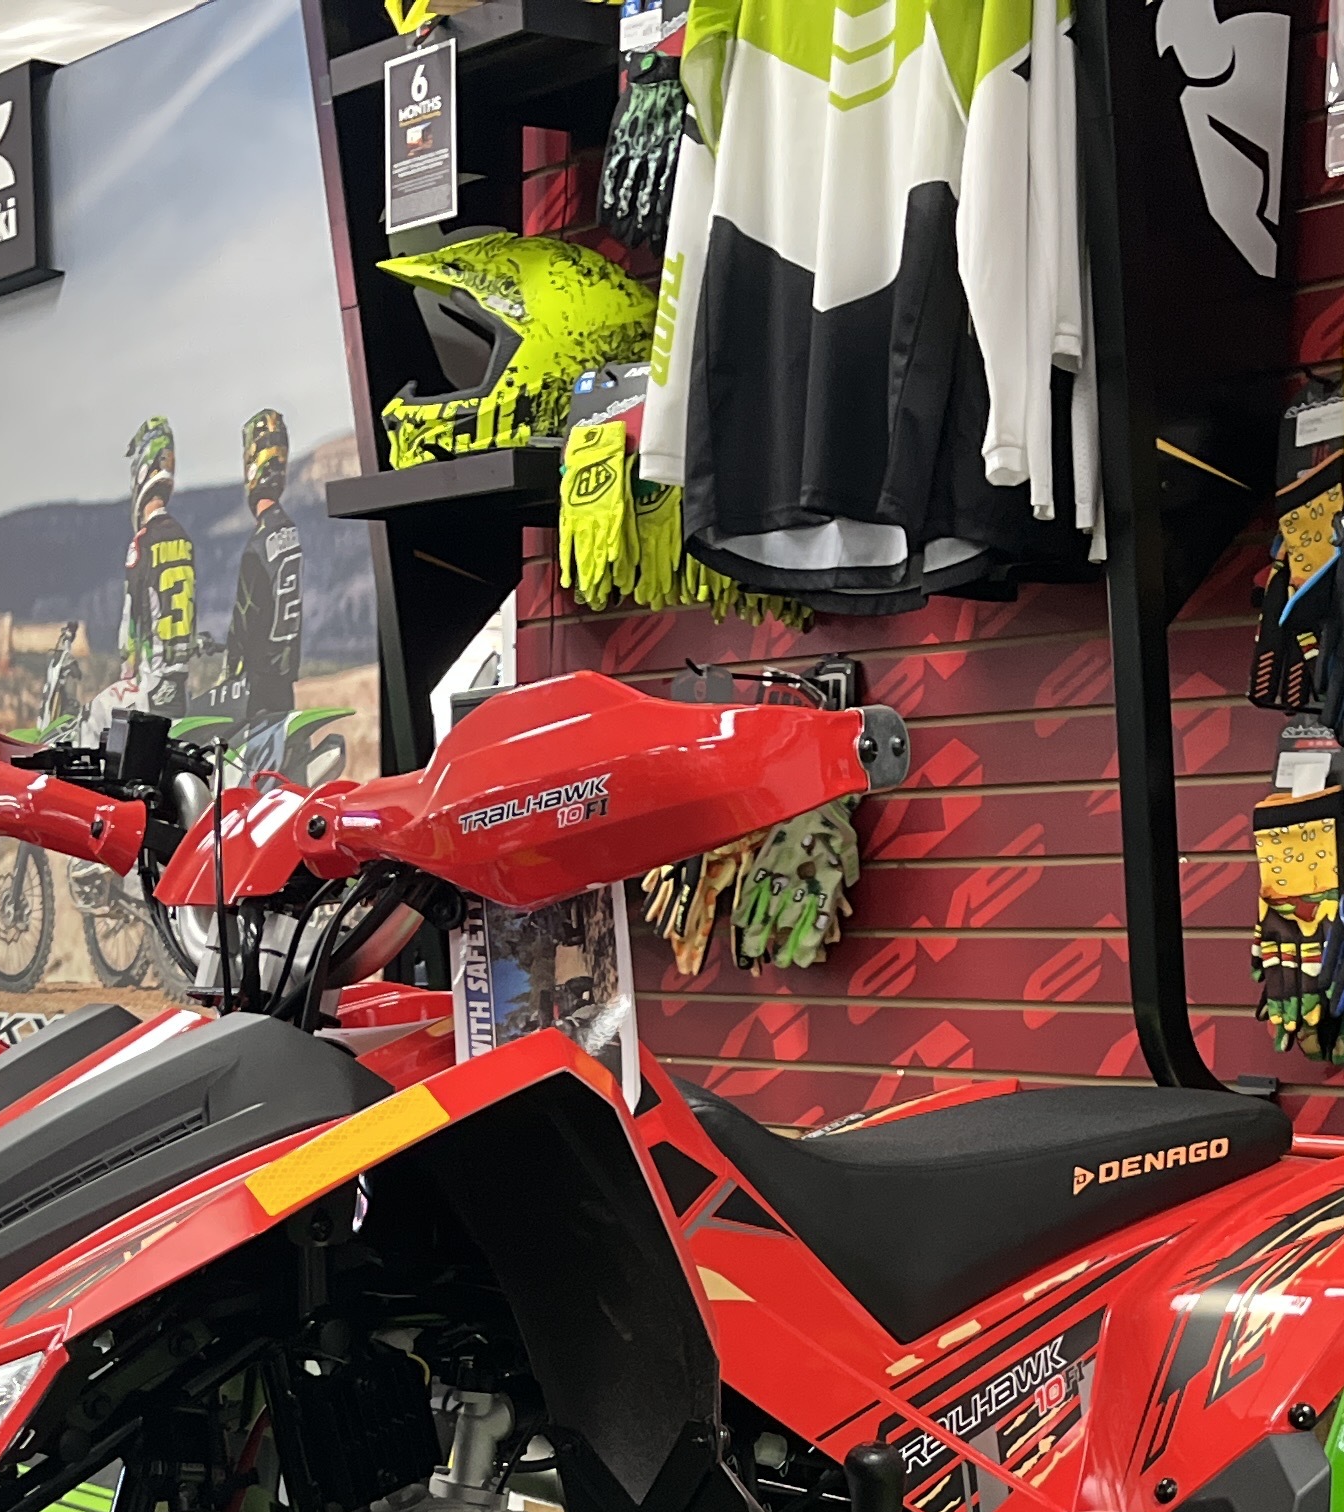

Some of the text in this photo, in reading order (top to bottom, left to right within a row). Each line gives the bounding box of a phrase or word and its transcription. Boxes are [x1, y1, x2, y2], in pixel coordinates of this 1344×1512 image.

[410, 63, 429, 103] 6
[398, 95, 443, 123] MONTHS
[1098, 1136, 1230, 1184] DENAGO
